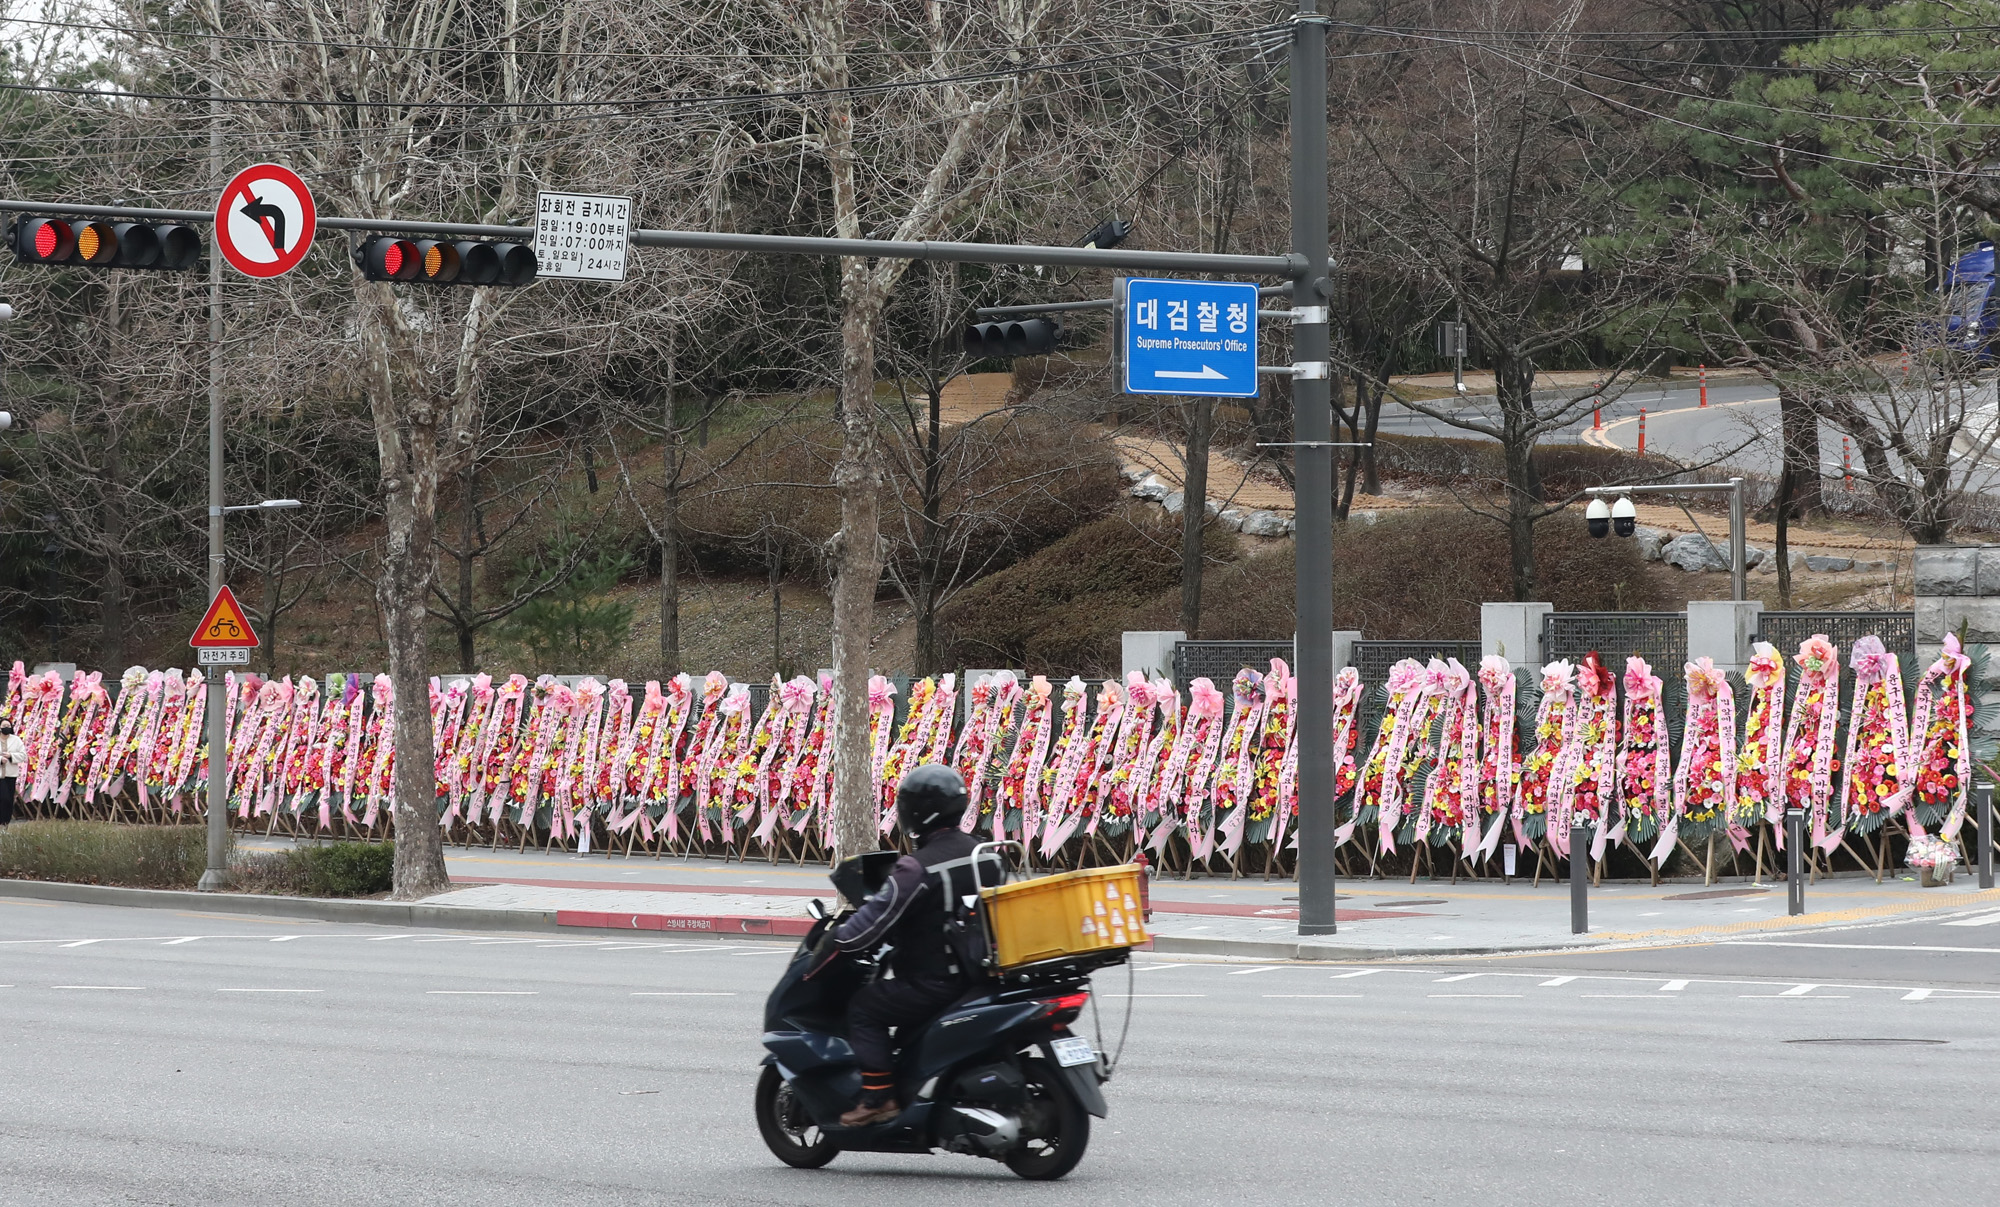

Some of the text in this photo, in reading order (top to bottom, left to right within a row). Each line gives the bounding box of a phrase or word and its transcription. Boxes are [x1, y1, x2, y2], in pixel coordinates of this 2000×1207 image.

[540, 198, 626, 220] 좌회전 금지시간
[588, 258, 621, 271] 24시간
[1136, 299, 1248, 334] 대검찰청
[1136, 336, 1248, 352] Supreme Prosecutors' Office
[1822, 714, 1834, 732] 비리
[1464, 733, 1474, 750] 비리
[1818, 736, 1832, 753] 수사
[1464, 754, 1474, 770] 수사
[1816, 757, 1830, 776] 기소
[1463, 774, 1474, 791] 기소
